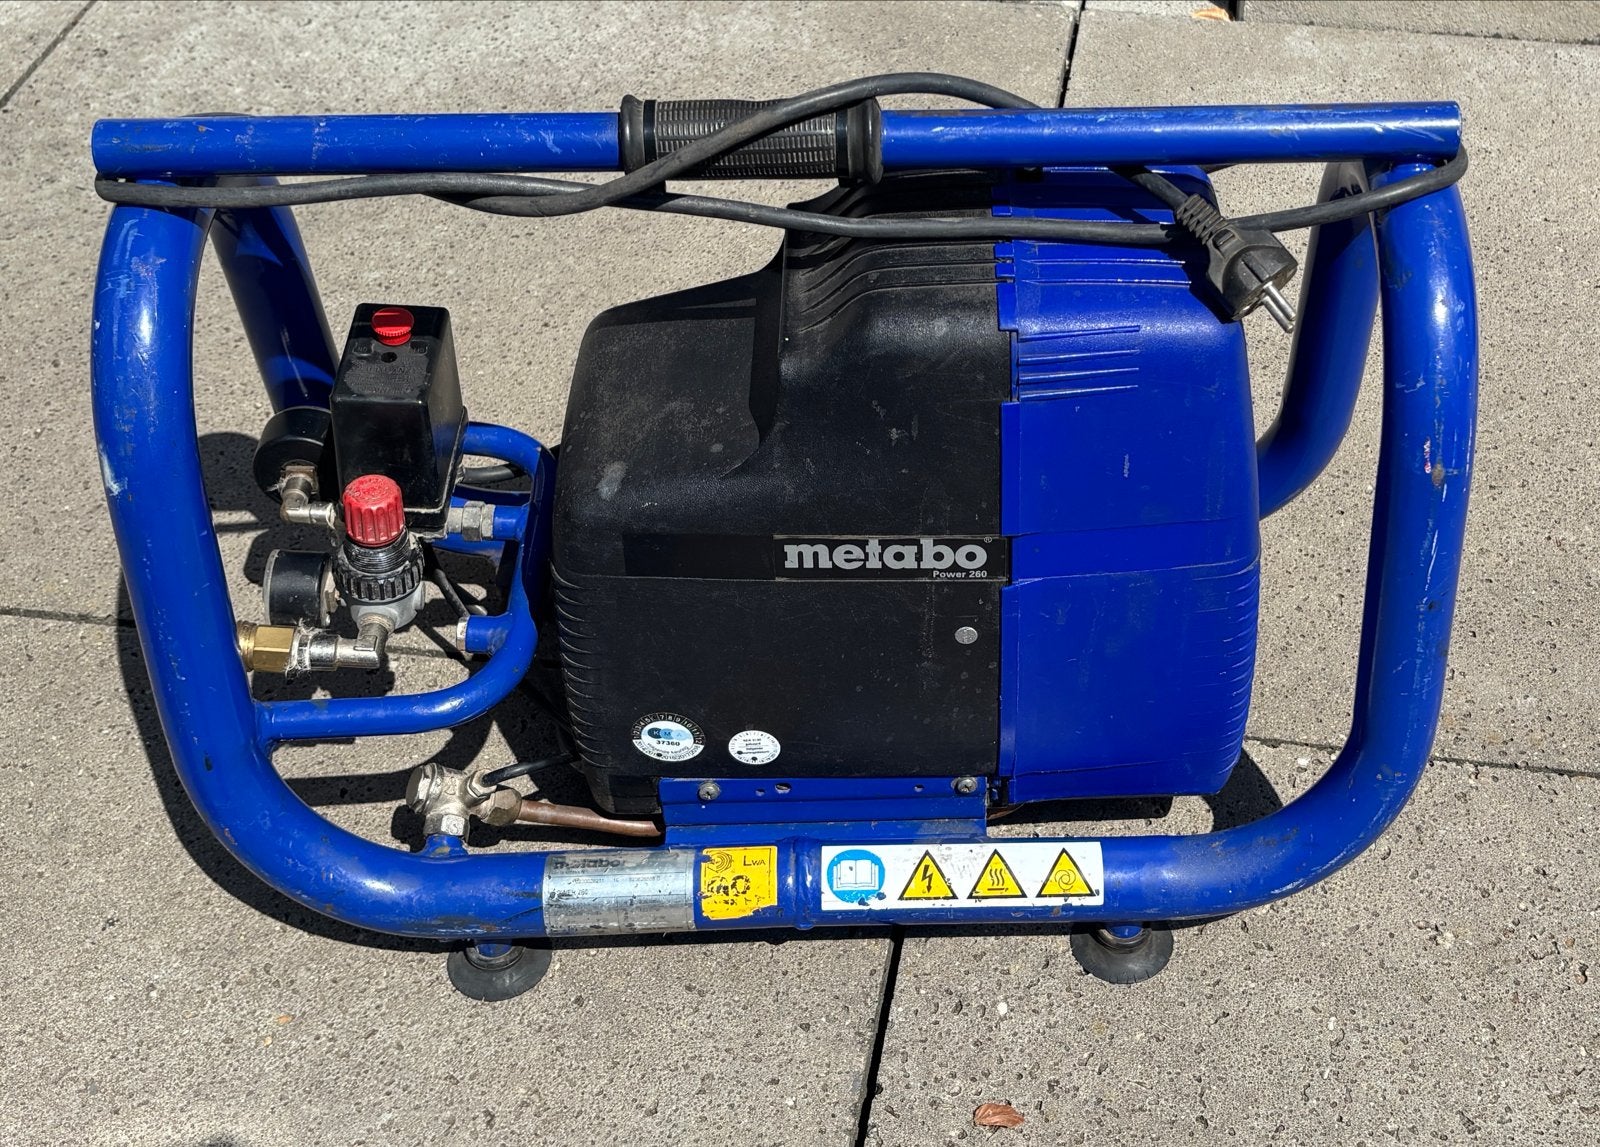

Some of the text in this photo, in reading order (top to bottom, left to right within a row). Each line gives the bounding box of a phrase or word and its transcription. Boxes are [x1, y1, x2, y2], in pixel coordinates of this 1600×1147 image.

[783, 537, 988, 570] metabo
[933, 570, 988, 578] Power 260
